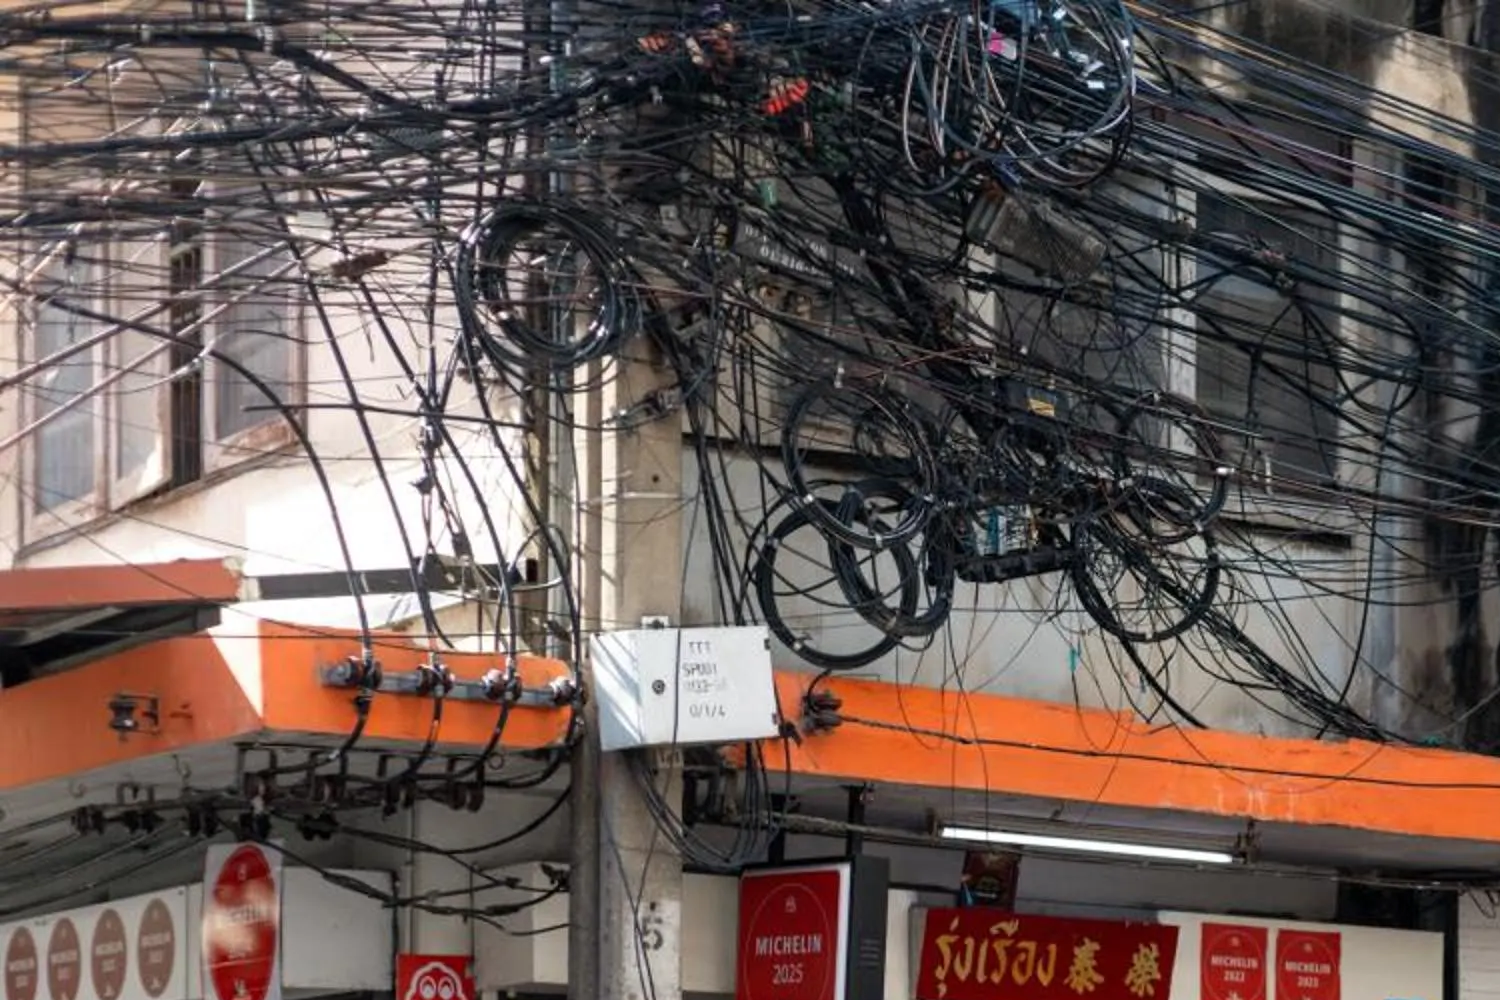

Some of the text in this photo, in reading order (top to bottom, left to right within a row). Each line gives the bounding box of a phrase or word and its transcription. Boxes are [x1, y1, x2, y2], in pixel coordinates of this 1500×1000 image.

[755, 933, 823, 957] MICHELIN
[935, 916, 1057, 999] รุ่งเรือง
[1211, 954, 1258, 969] MICHELIN
[1285, 960, 1331, 975] MICHELIN
[772, 962, 804, 985] 2025
